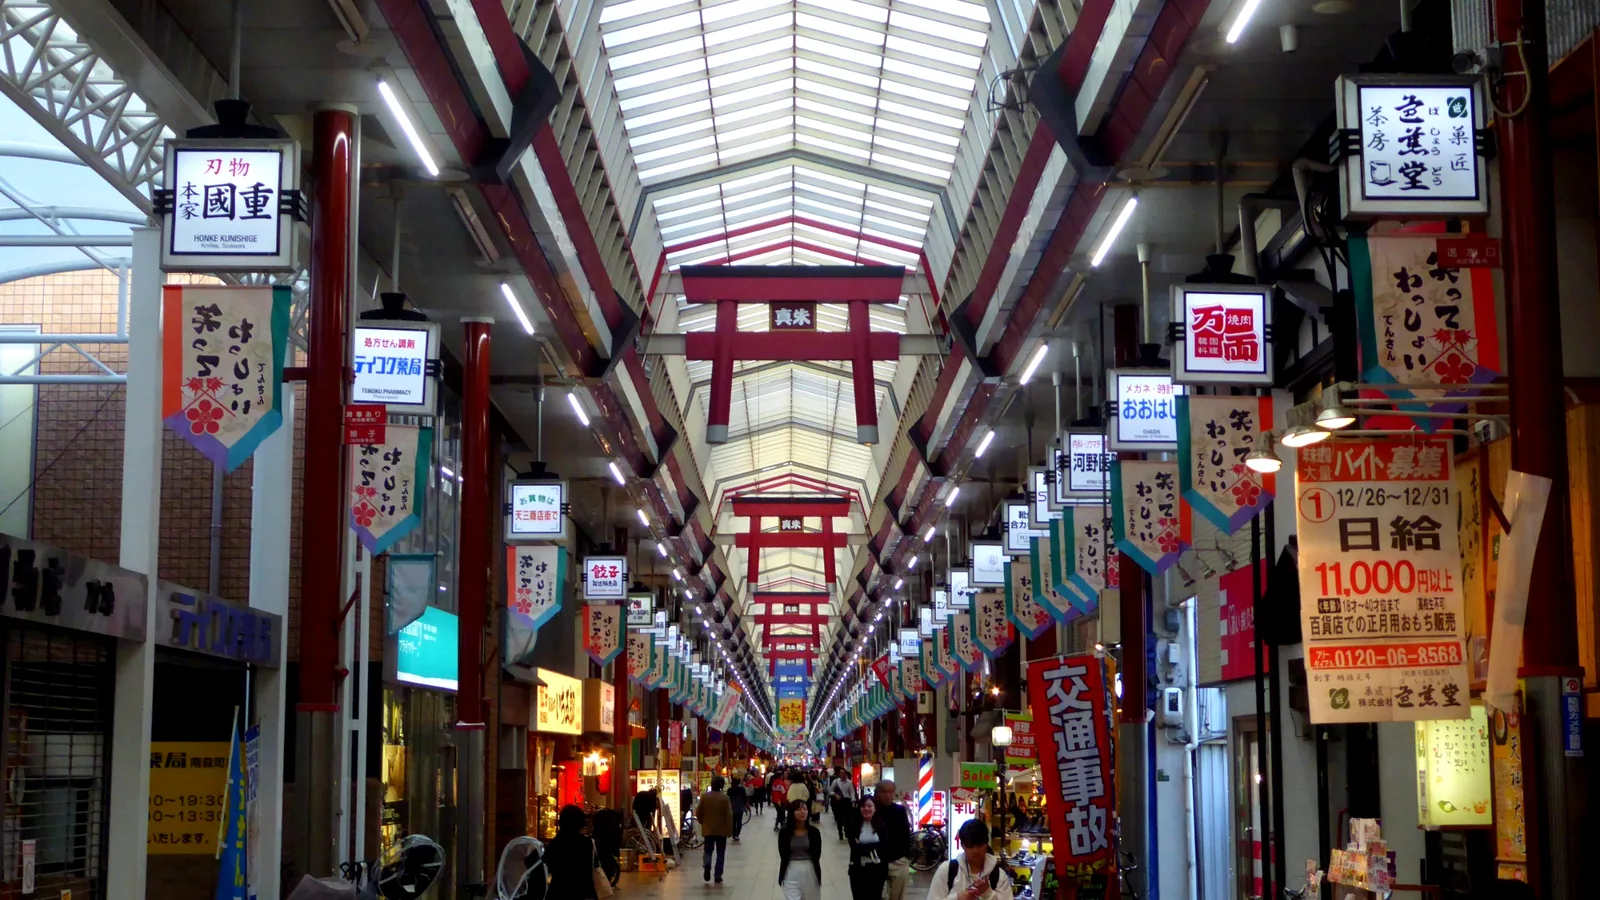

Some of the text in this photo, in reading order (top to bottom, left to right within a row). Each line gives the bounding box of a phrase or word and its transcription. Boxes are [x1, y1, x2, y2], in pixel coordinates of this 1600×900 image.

[1366, 105, 1390, 152] 茶房
[1394, 94, 1430, 190] 芭蕉堂
[1448, 125, 1470, 172] 菓匠
[204, 158, 250, 177] 刃物
[179, 181, 200, 220] 本家
[202, 182, 273, 221] 國重
[194, 234, 258, 243] HONKE KUNISHIGE
[1227, 314, 1251, 326] 焼肉
[1393, 266, 1427, 370] わっしょい
[364, 337, 415, 349] 処方せん調剤
[1382, 314, 1396, 361] てんさん
[383, 388, 411, 396] PHARMACY
[1196, 453, 1205, 486] てんさん
[1205, 420, 1227, 493] わっしょい
[1334, 445, 1444, 480] バイト 募集
[519, 494, 554, 506] お買物は
[1155, 471, 1175, 517] 笑って
[515, 510, 558, 521] 天三商店街で
[1135, 481, 1153, 542] わっしょい
[1084, 523, 1099, 576] わっしょい
[1339, 515, 1442, 552] 日給
[591, 564, 620, 579] 餃子
[1309, 612, 1456, 636] 百貨店での正月用おもち販売
[1334, 645, 1459, 668] 0120-06-8568
[1358, 698, 1393, 708] 株式会社
[1395, 683, 1461, 708] 芭蕉堂
[190, 757, 230, 769] 南森町
[1043, 665, 1109, 857] 交通事故
